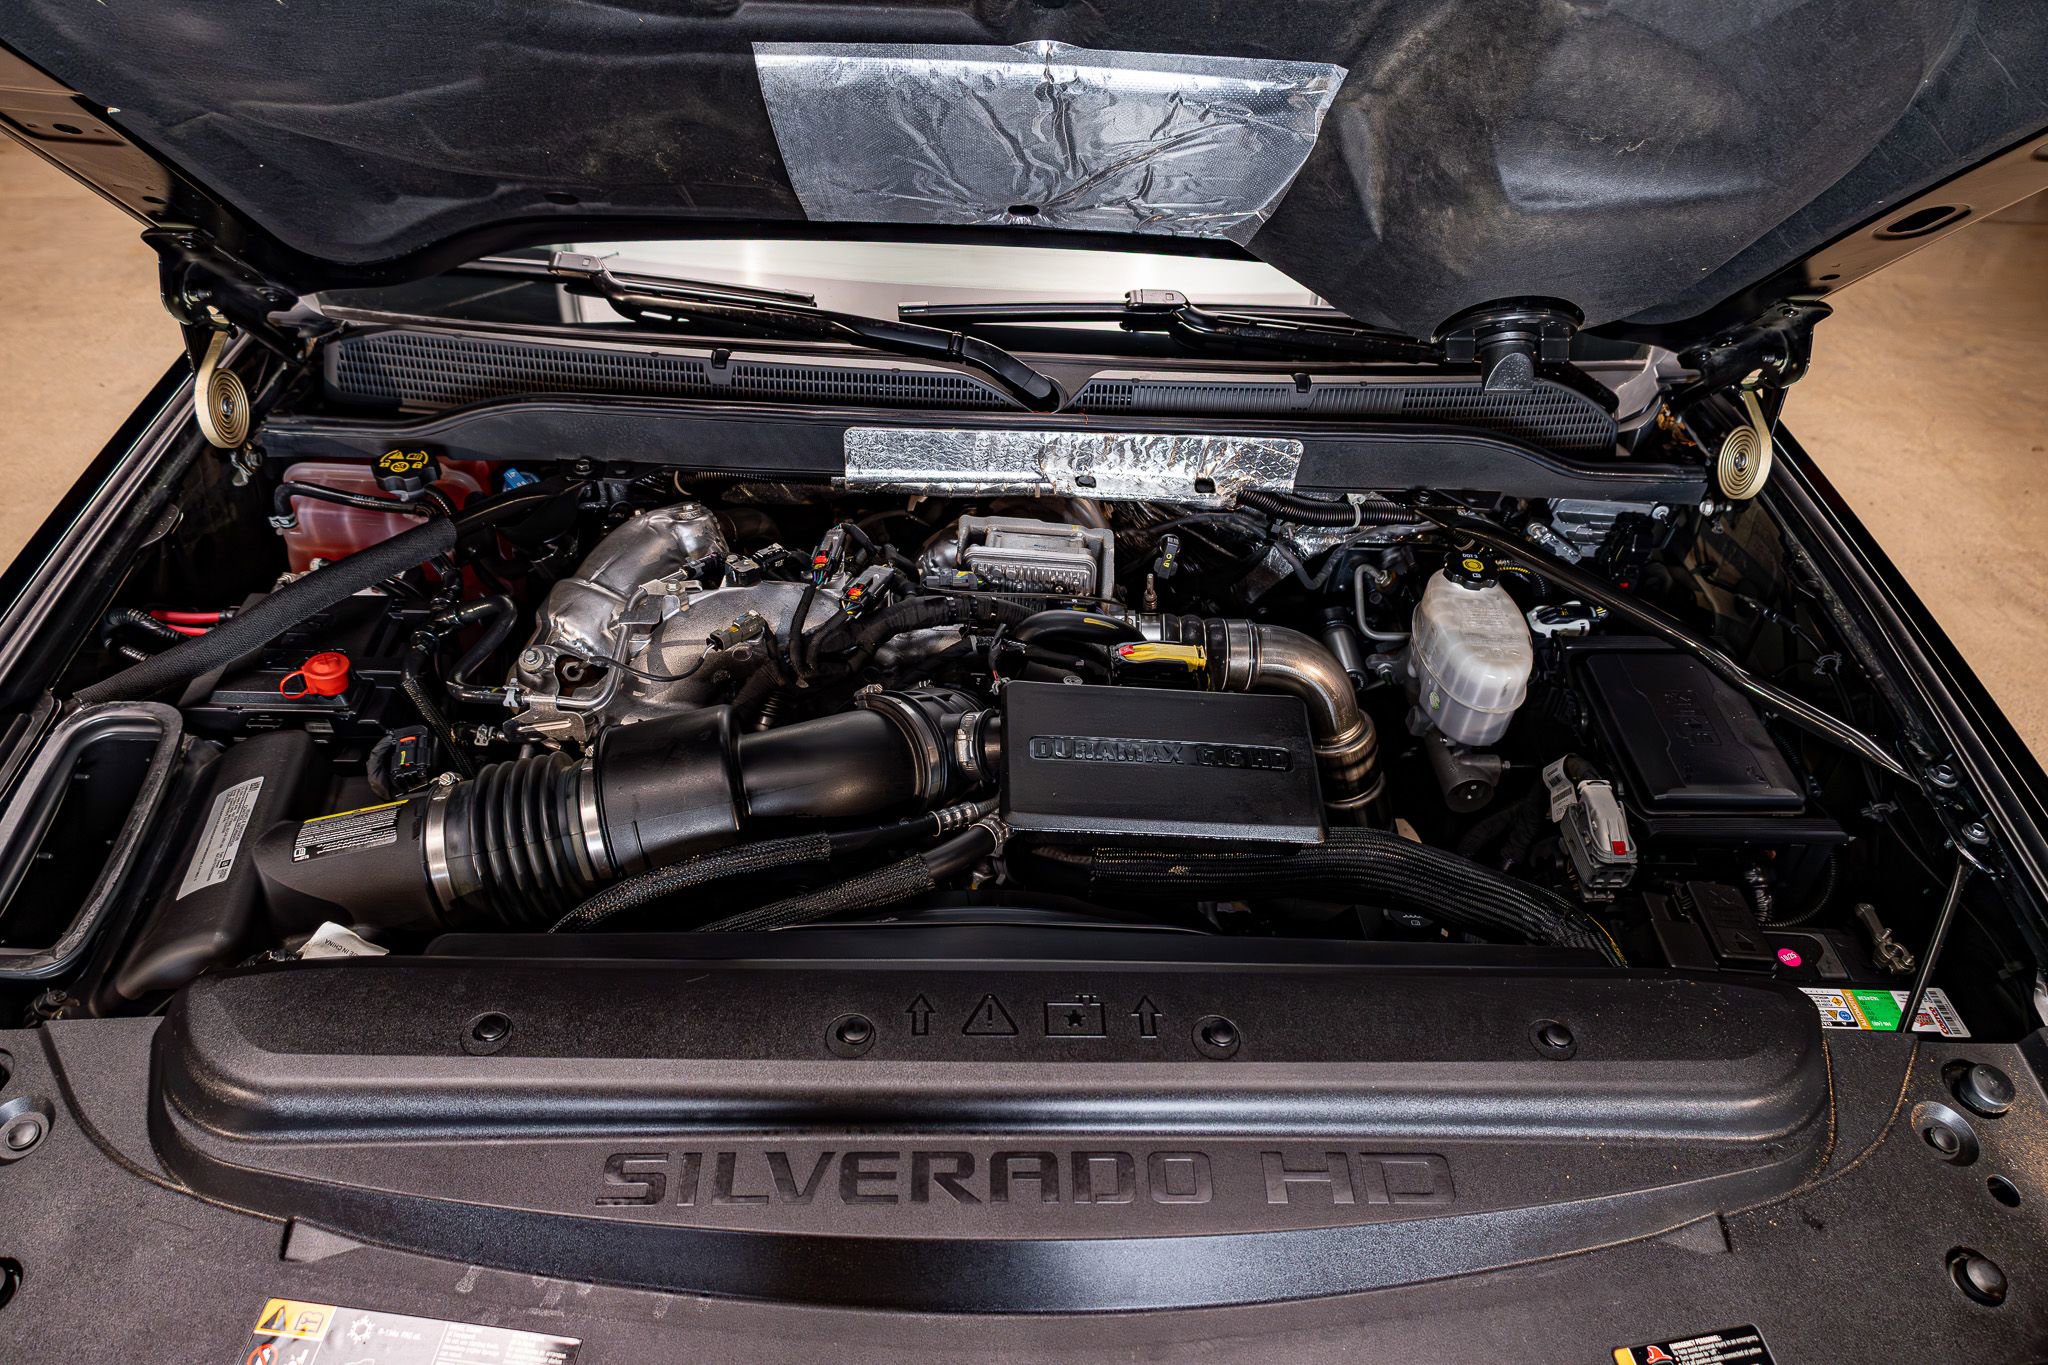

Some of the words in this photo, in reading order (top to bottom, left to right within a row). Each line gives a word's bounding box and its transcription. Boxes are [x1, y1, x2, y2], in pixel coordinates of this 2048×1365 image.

[1034, 738, 1184, 764] DURAMAX
[324, 938, 343, 952] CHINA
[1928, 1006, 1949, 1035] COSTCO
[596, 1151, 1213, 1206] SILVERADO
[1261, 1151, 1456, 1205] HD
